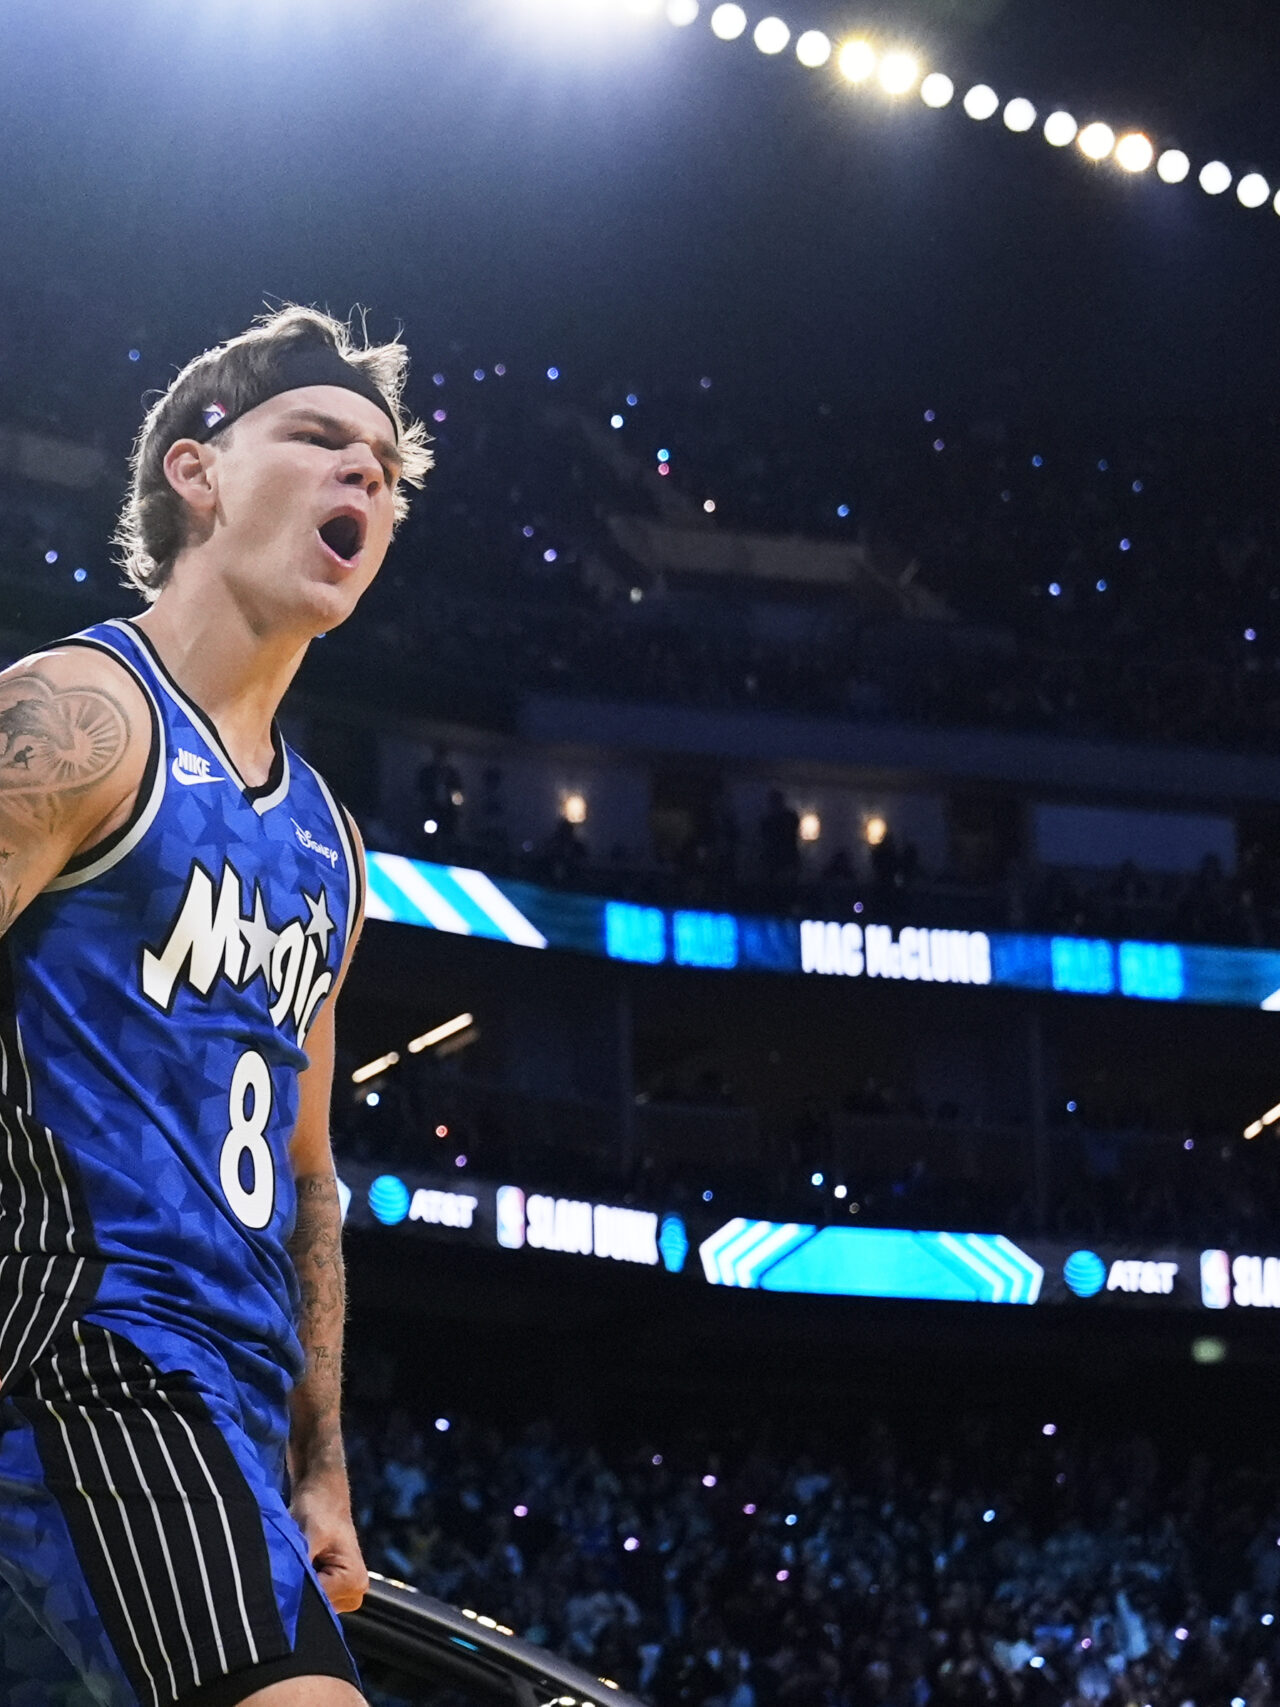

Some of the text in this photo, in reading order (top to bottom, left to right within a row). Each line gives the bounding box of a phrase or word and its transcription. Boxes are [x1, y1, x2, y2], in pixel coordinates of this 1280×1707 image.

[177, 747, 211, 778] NIKE
[800, 919, 864, 978] MAC
[219, 1049, 275, 1230] 8
[1106, 1254, 1280, 1309] AT&T SLA
